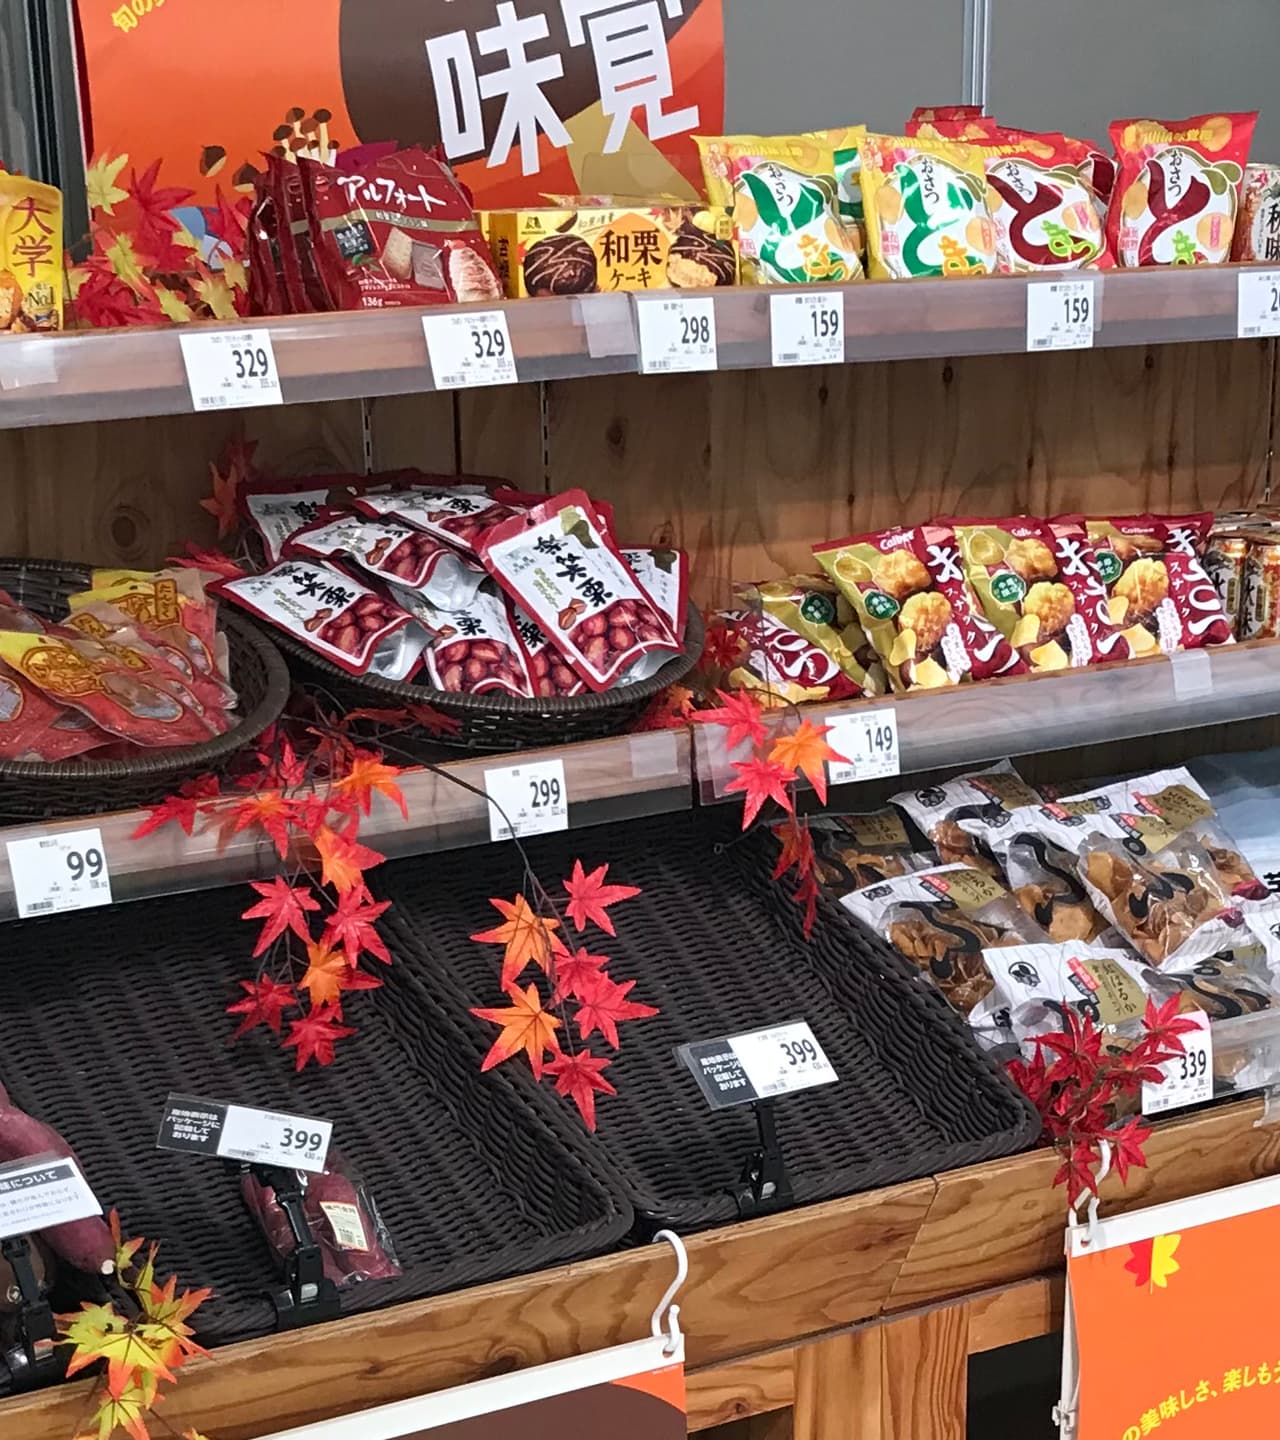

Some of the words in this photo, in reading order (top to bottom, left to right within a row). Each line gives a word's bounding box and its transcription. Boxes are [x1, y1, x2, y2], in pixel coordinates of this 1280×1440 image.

[425, 0, 700, 176] 味覚
[921, 157, 940, 204] おさつ
[1168, 150, 1184, 197] おさつ
[337, 175, 447, 212] アルフォート
[11, 196, 55, 277] 大学
[599, 228, 663, 268] 和栗
[610, 267, 652, 290] ケーキ
[811, 310, 839, 337] 159
[1064, 297, 1089, 323] 159
[471, 329, 505, 359] 329
[680, 316, 710, 344] 298
[232, 348, 268, 379] 329
[1170, 561, 1189, 619] スナック
[865, 726, 893, 753] 149
[530, 778, 561, 809] 299
[66, 848, 103, 881] 99
[780, 1038, 817, 1065] 399
[1179, 1050, 1207, 1081] 339
[166, 1114, 220, 1130] パッケージに
[172, 1131, 209, 1143] おります
[280, 1127, 323, 1151] 399
